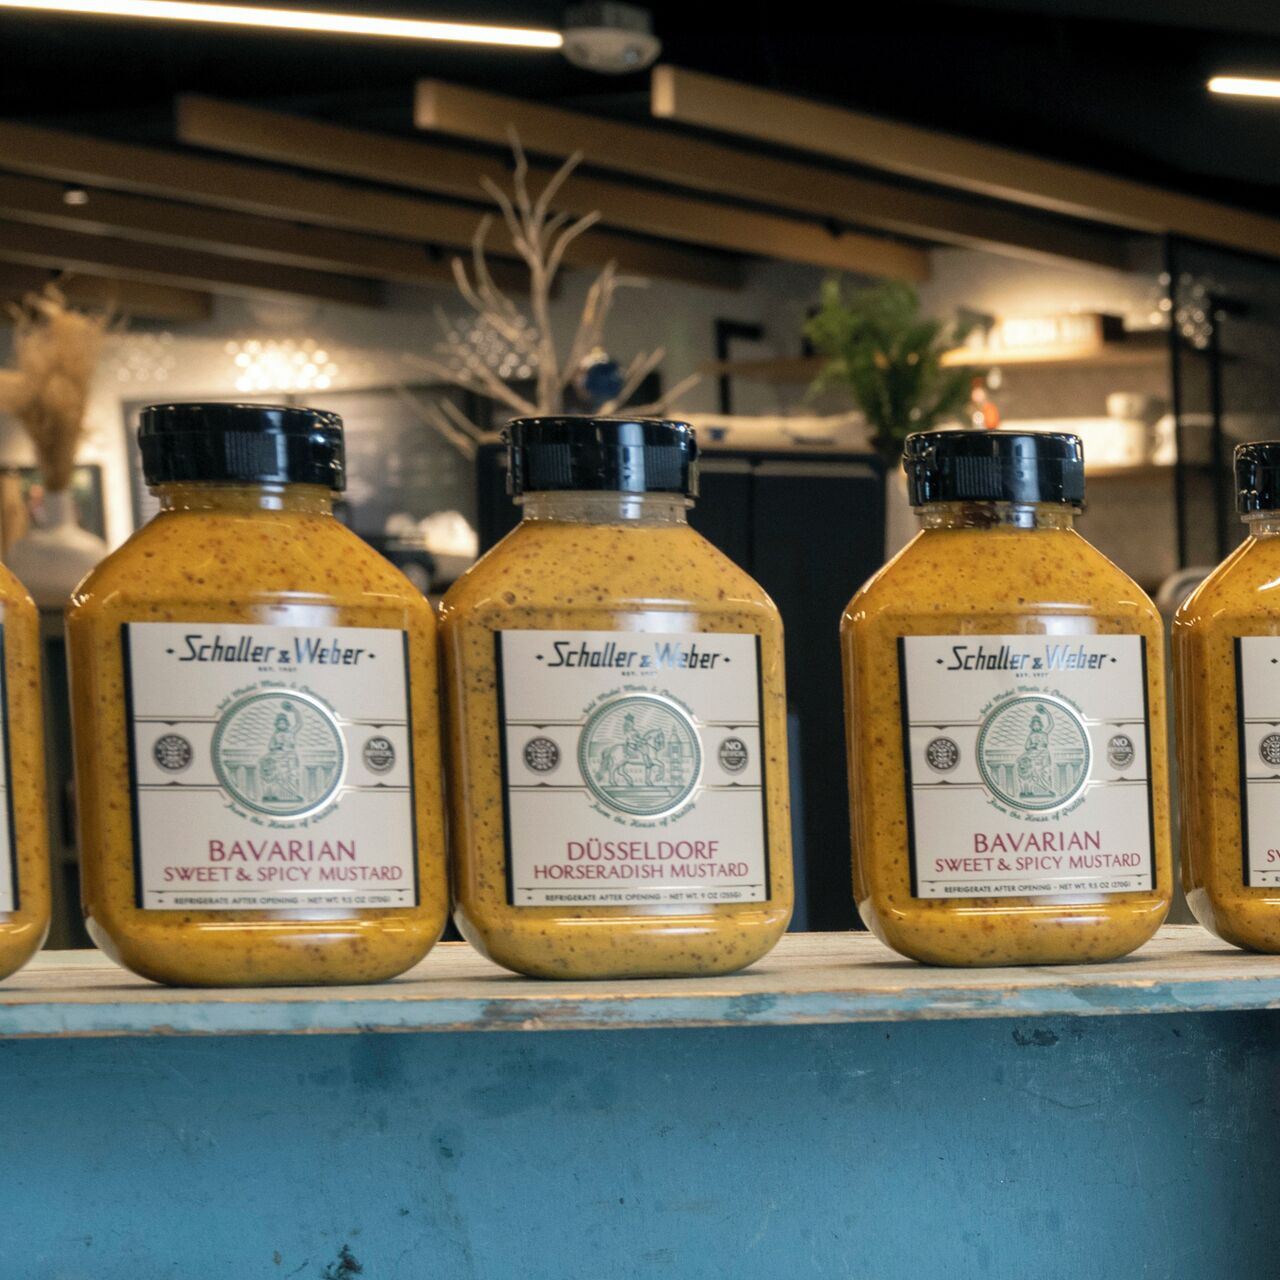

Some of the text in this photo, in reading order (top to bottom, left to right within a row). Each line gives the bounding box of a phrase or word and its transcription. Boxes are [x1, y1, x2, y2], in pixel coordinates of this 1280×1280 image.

[179, 634, 366, 665] Schaller & Weber
[547, 641, 639, 669] Schaller
[654, 642, 721, 670] Weber
[947, 644, 1108, 671] Schaller & Weber
[208, 839, 356, 862] BAVARIAN
[567, 837, 720, 861] DÜSSELDORF
[974, 830, 1101, 853] BAVARIAN
[163, 865, 403, 882] SWEET & SPICY MUSTARD
[533, 861, 749, 881] HORSERADISH MUSTARD
[935, 852, 1141, 873] SWEET & SPICY MUSTARD
